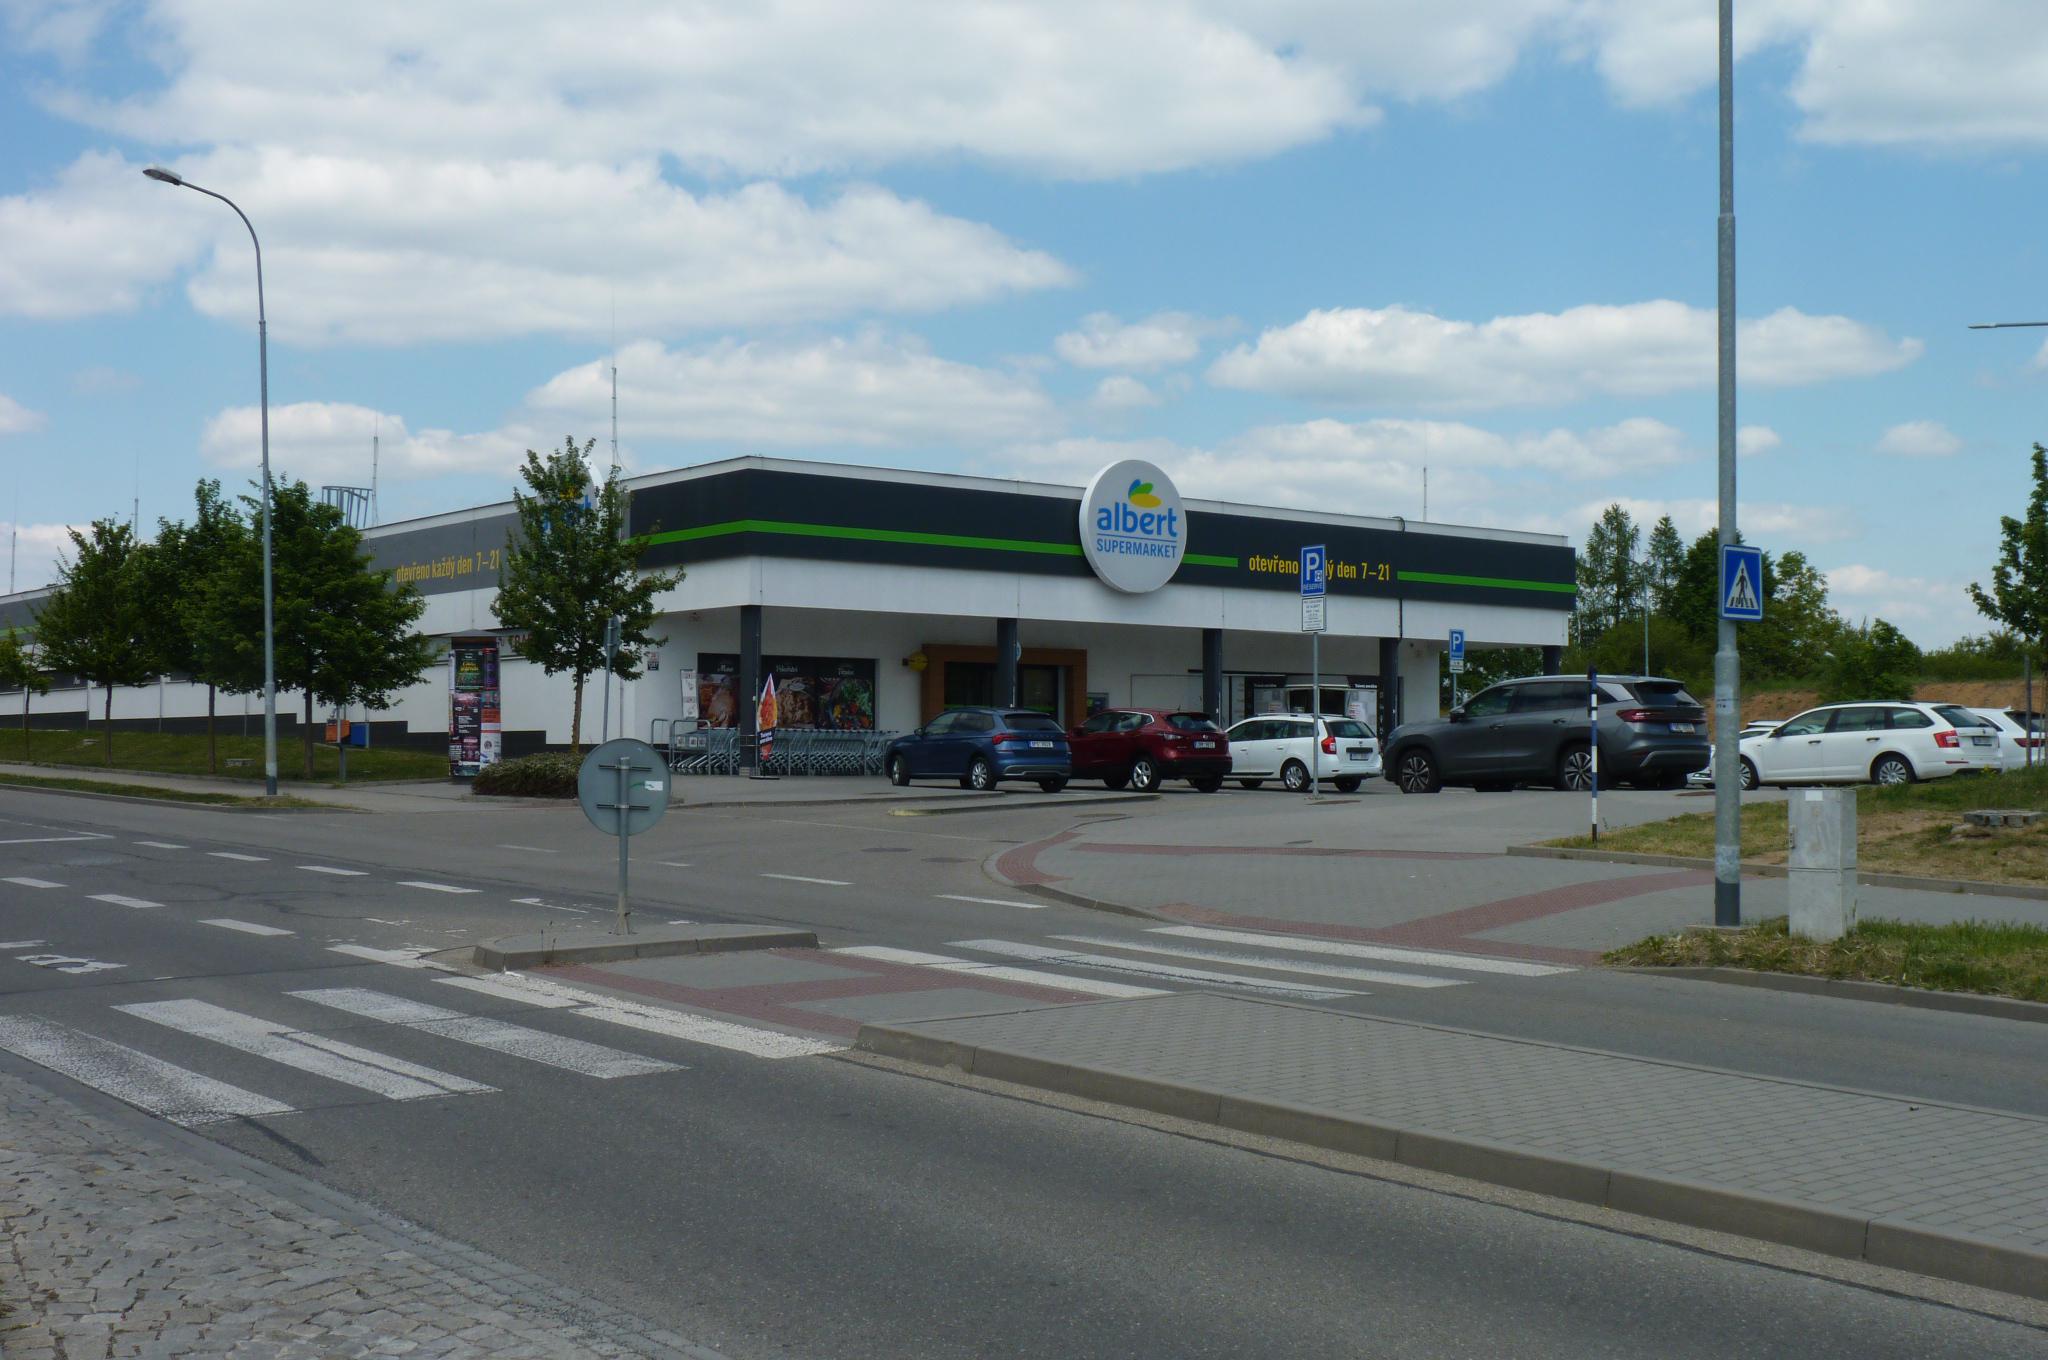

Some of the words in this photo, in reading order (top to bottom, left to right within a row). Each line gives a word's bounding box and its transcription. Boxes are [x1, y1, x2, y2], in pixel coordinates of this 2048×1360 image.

[1096, 502, 1178, 537] albert
[1096, 538, 1177, 558] SUPERMARKET
[396, 561, 430, 583] otevřeno
[432, 555, 455, 579] každý
[457, 555, 472, 575] den
[1249, 554, 1299, 574] otevřeno
[1337, 561, 1356, 578] den
[1306, 552, 1320, 581] P
[1453, 633, 1461, 650] P
